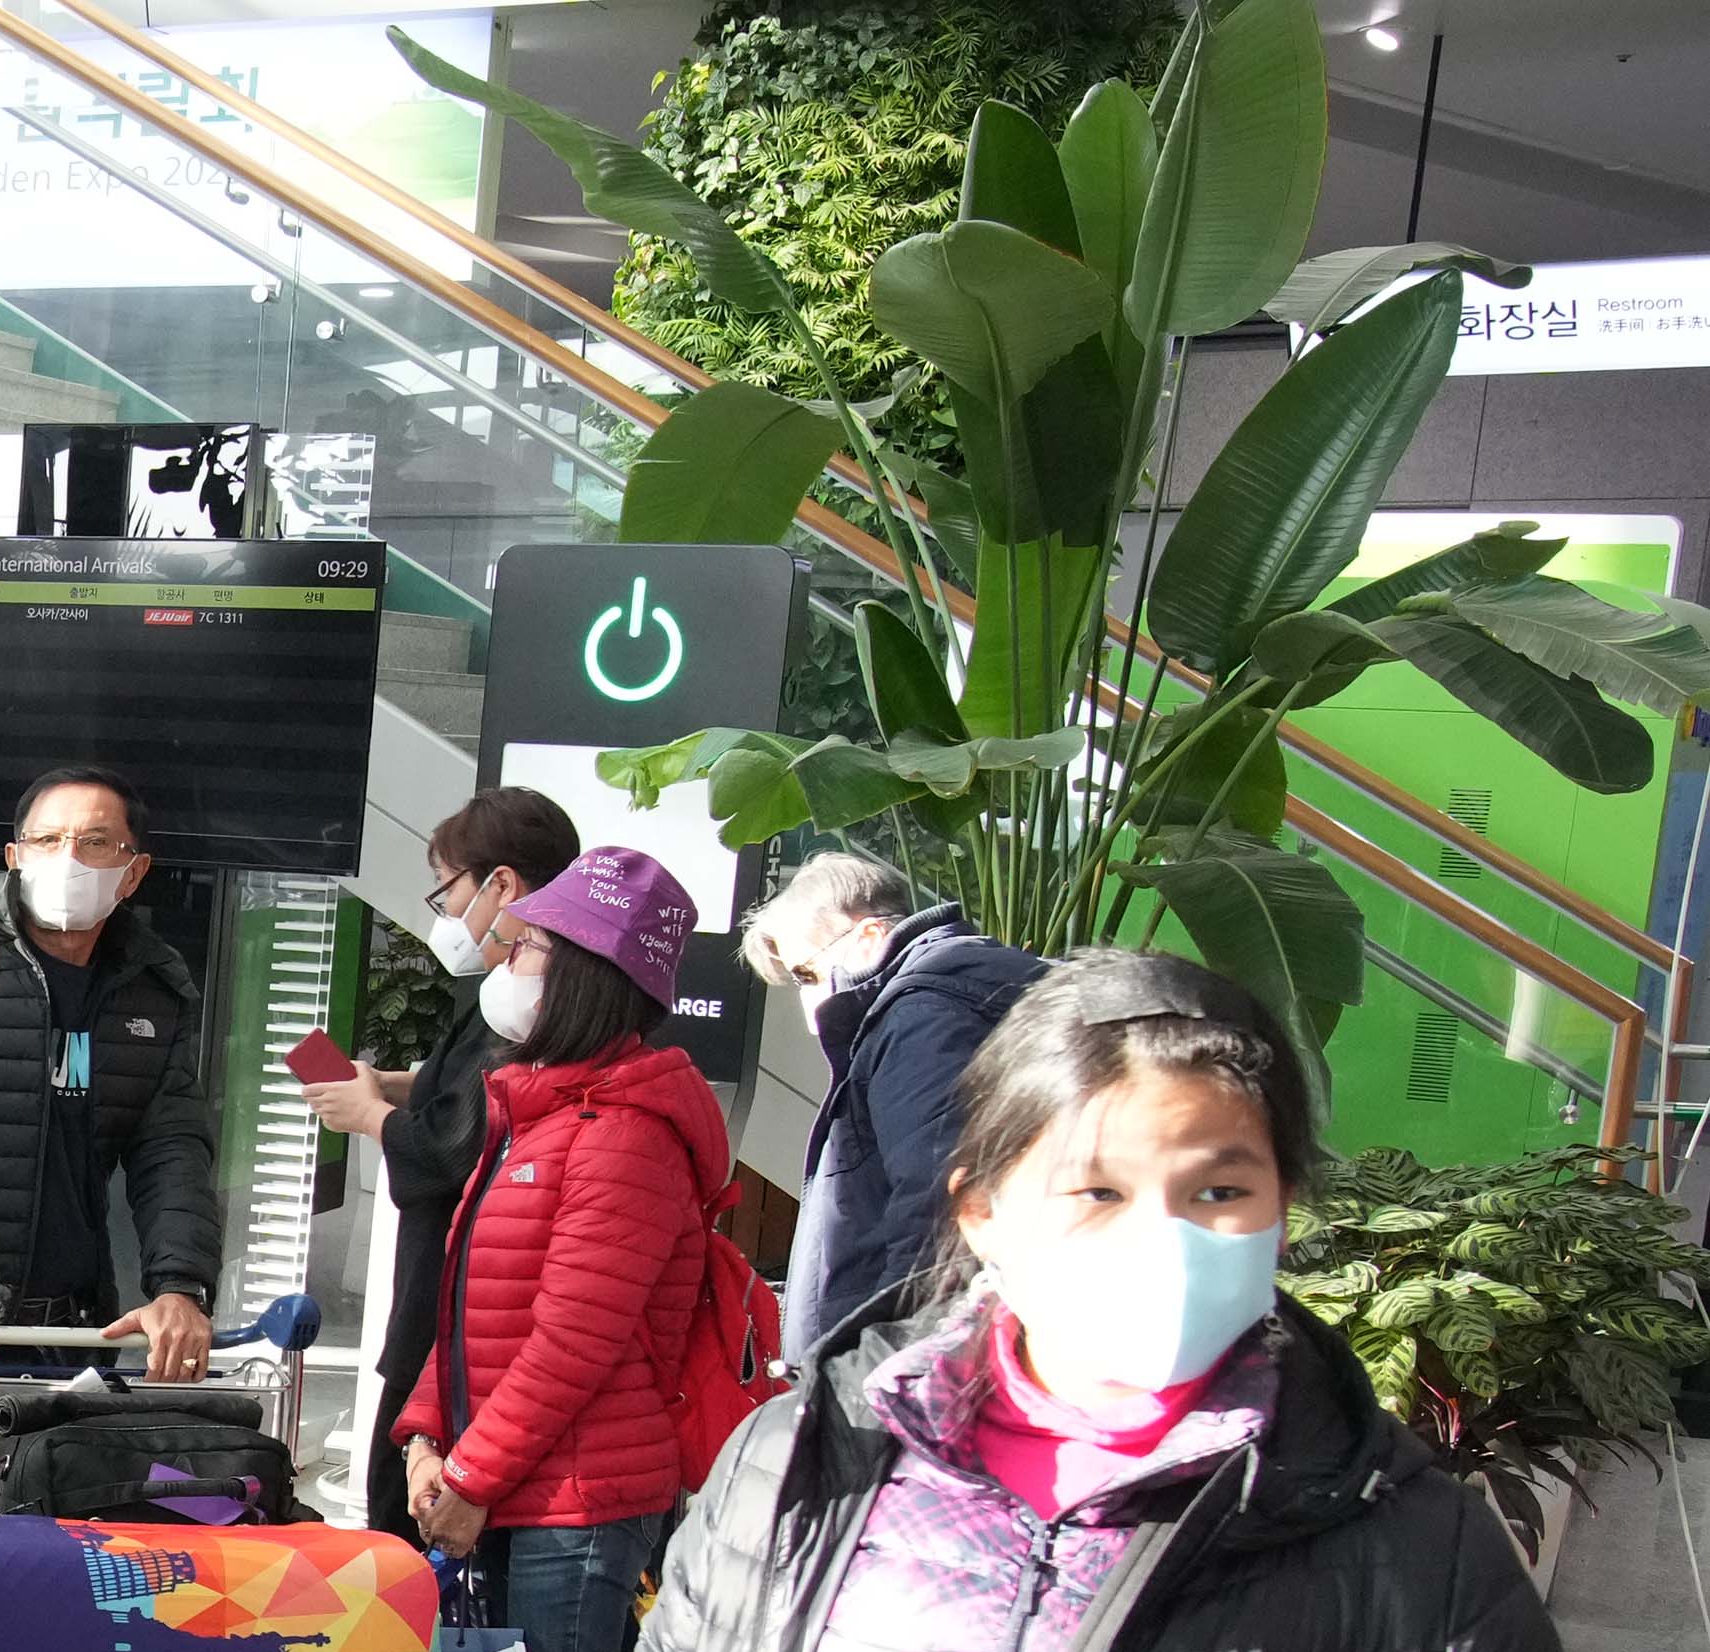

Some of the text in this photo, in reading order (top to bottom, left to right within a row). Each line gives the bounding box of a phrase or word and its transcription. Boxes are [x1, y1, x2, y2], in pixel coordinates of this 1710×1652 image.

[1597, 297, 1683, 312] Restroom
[1458, 300, 1578, 341] 화장실
[91, 557, 153, 575] Arrivals
[317, 560, 368, 578] 09:29
[304, 591, 325, 603] 상태
[25, 608, 89, 621] 오사카/간사이
[199, 612, 214, 624] 7C
[218, 612, 243, 624] 1311
[658, 905, 689, 922] WTF
[56, 1089, 87, 1097] CULT
